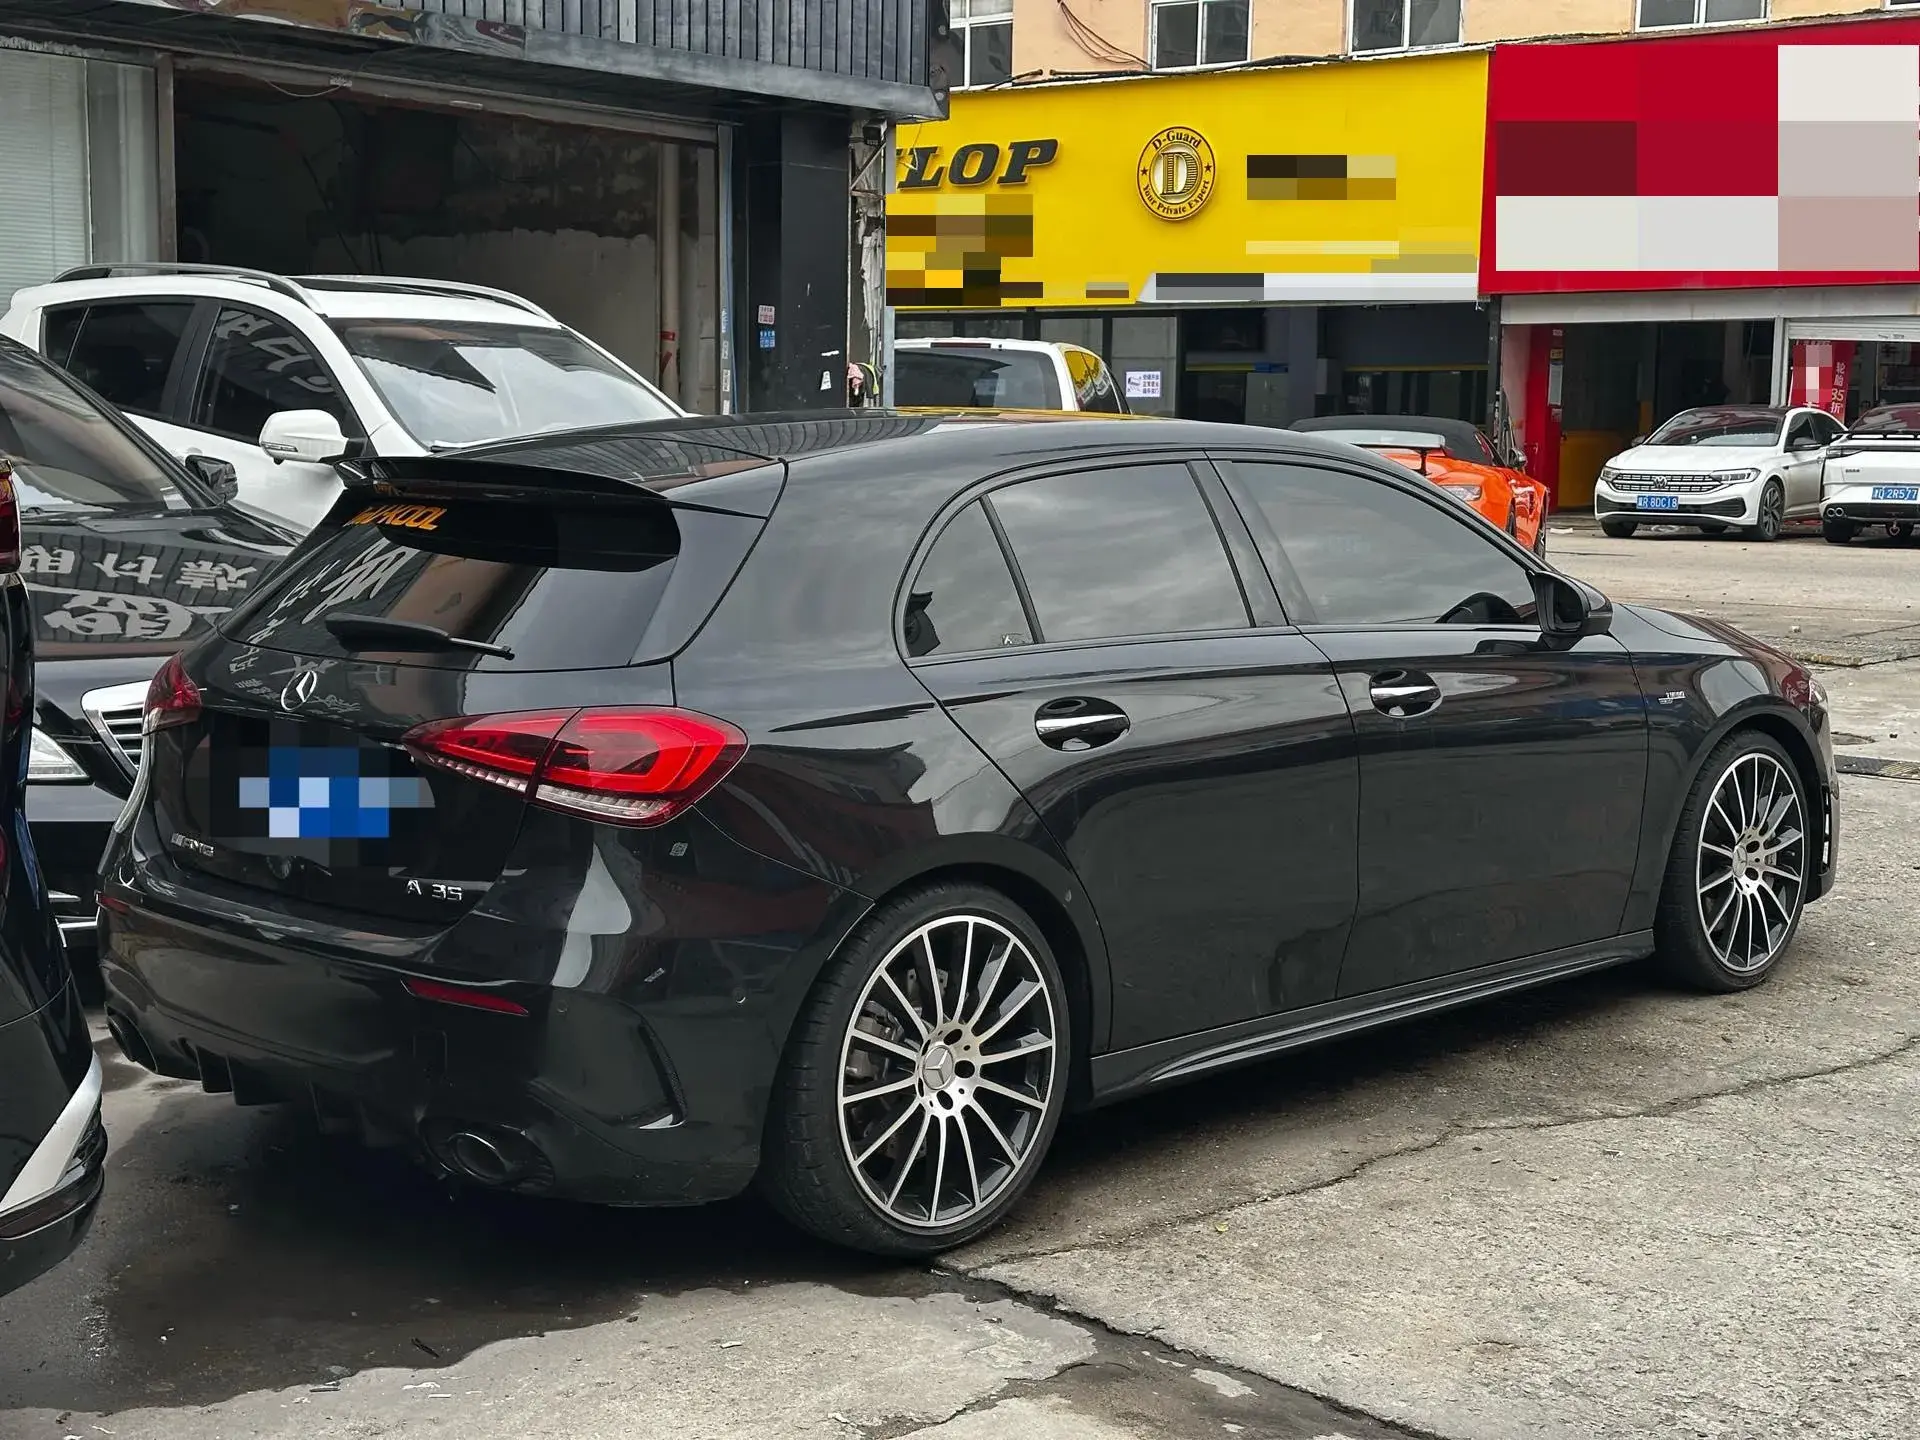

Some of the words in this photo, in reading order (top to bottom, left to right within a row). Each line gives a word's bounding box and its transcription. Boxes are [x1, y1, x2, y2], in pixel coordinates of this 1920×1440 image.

[1152, 130, 1202, 150] D-Guard
[896, 138, 1059, 189] LOP
[1143, 183, 1158, 205] Your
[1157, 202, 1187, 215] Private
[1188, 180, 1209, 208] Expert
[407, 880, 421, 895] A
[431, 884, 462, 900] 35
